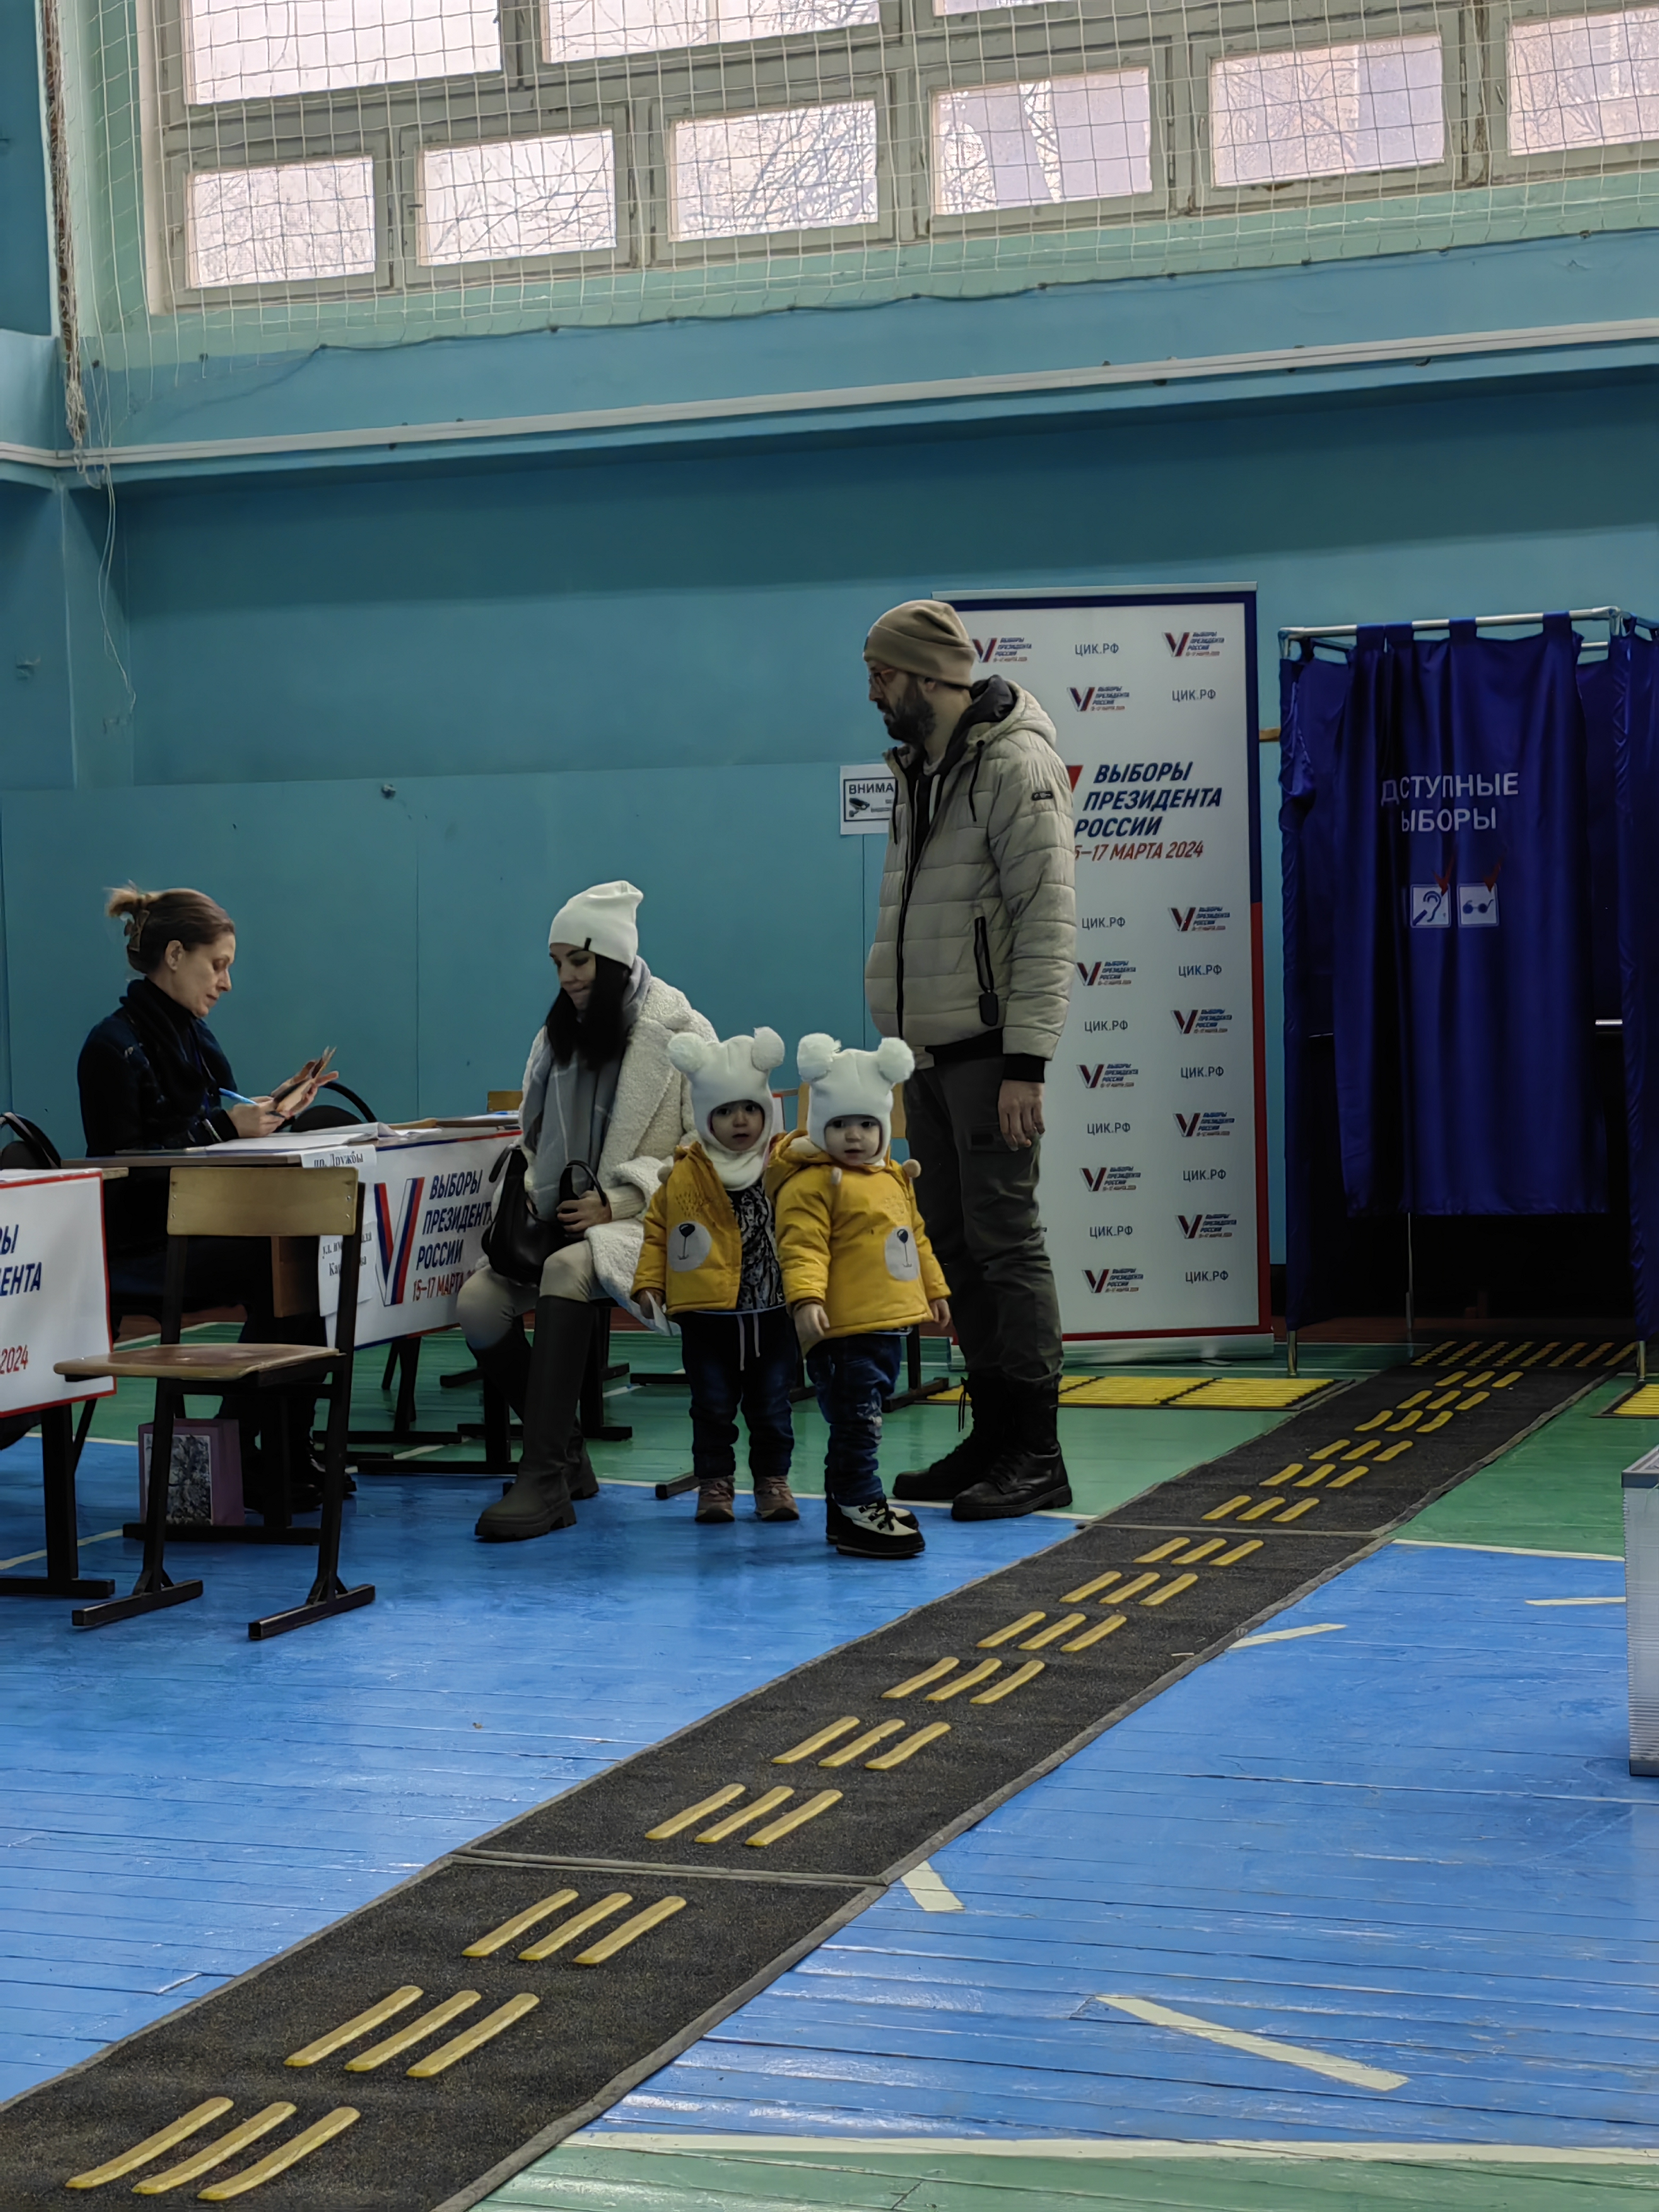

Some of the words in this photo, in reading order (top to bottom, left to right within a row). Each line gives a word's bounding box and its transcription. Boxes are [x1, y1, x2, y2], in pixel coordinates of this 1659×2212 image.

[1075, 643, 1119, 657] ЦИК.РФ
[1172, 689, 1216, 702] ЦИК.РФ
[1093, 761, 1193, 783] ВЫБОРЫ
[849, 783, 894, 794] ВНИМА
[1083, 787, 1222, 812] ПРЕЗИДЕНТА
[1075, 816, 1163, 838] РОССИИ
[1110, 842, 1163, 861] МАРТА
[1165, 840, 1203, 859] 2024
[1082, 917, 1125, 930] ЦИК.РФ
[1179, 965, 1222, 977] ЦИК.РФ
[1085, 1020, 1128, 1033] ЦИК.РФ
[1181, 1066, 1224, 1079] ЦИК.РФ
[1087, 1122, 1130, 1135] ЦИК.РФ
[1183, 1169, 1226, 1182] ЦИК.РФ
[429, 1169, 483, 1200] ВЫБОРЫ
[1090, 1226, 1133, 1239] ЦИК.РФ
[0, 1225, 19, 1255] Ы
[416, 1239, 464, 1270] РОССИИ
[0, 1262, 42, 1296] ЕНТА
[1186, 1270, 1228, 1284] ЦИК.РФ
[0, 1344, 28, 1375] 2024
